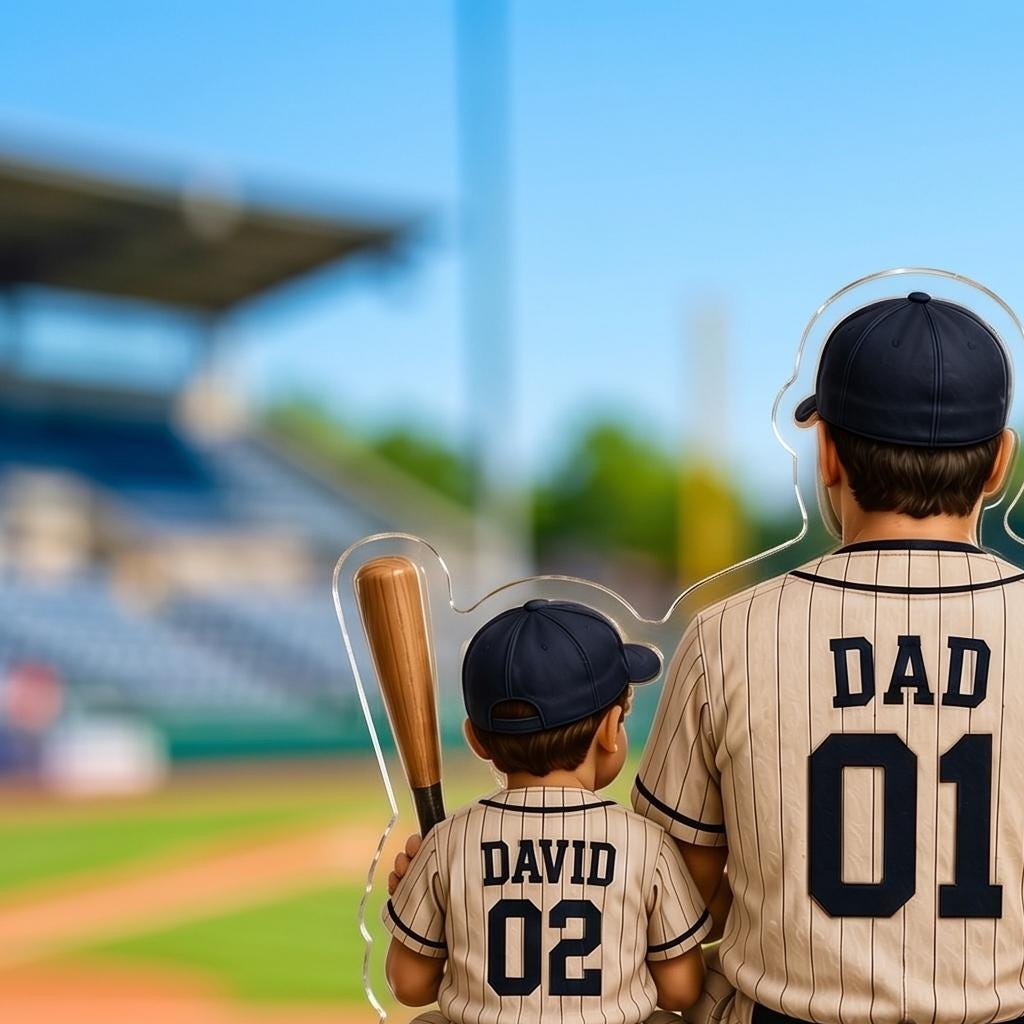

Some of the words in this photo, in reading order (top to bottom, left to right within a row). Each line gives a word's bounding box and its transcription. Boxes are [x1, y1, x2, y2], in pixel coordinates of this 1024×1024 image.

[832, 635, 991, 709] DAD
[482, 839, 616, 887] DAVID
[807, 733, 1003, 919] 01
[487, 899, 602, 996] 02
